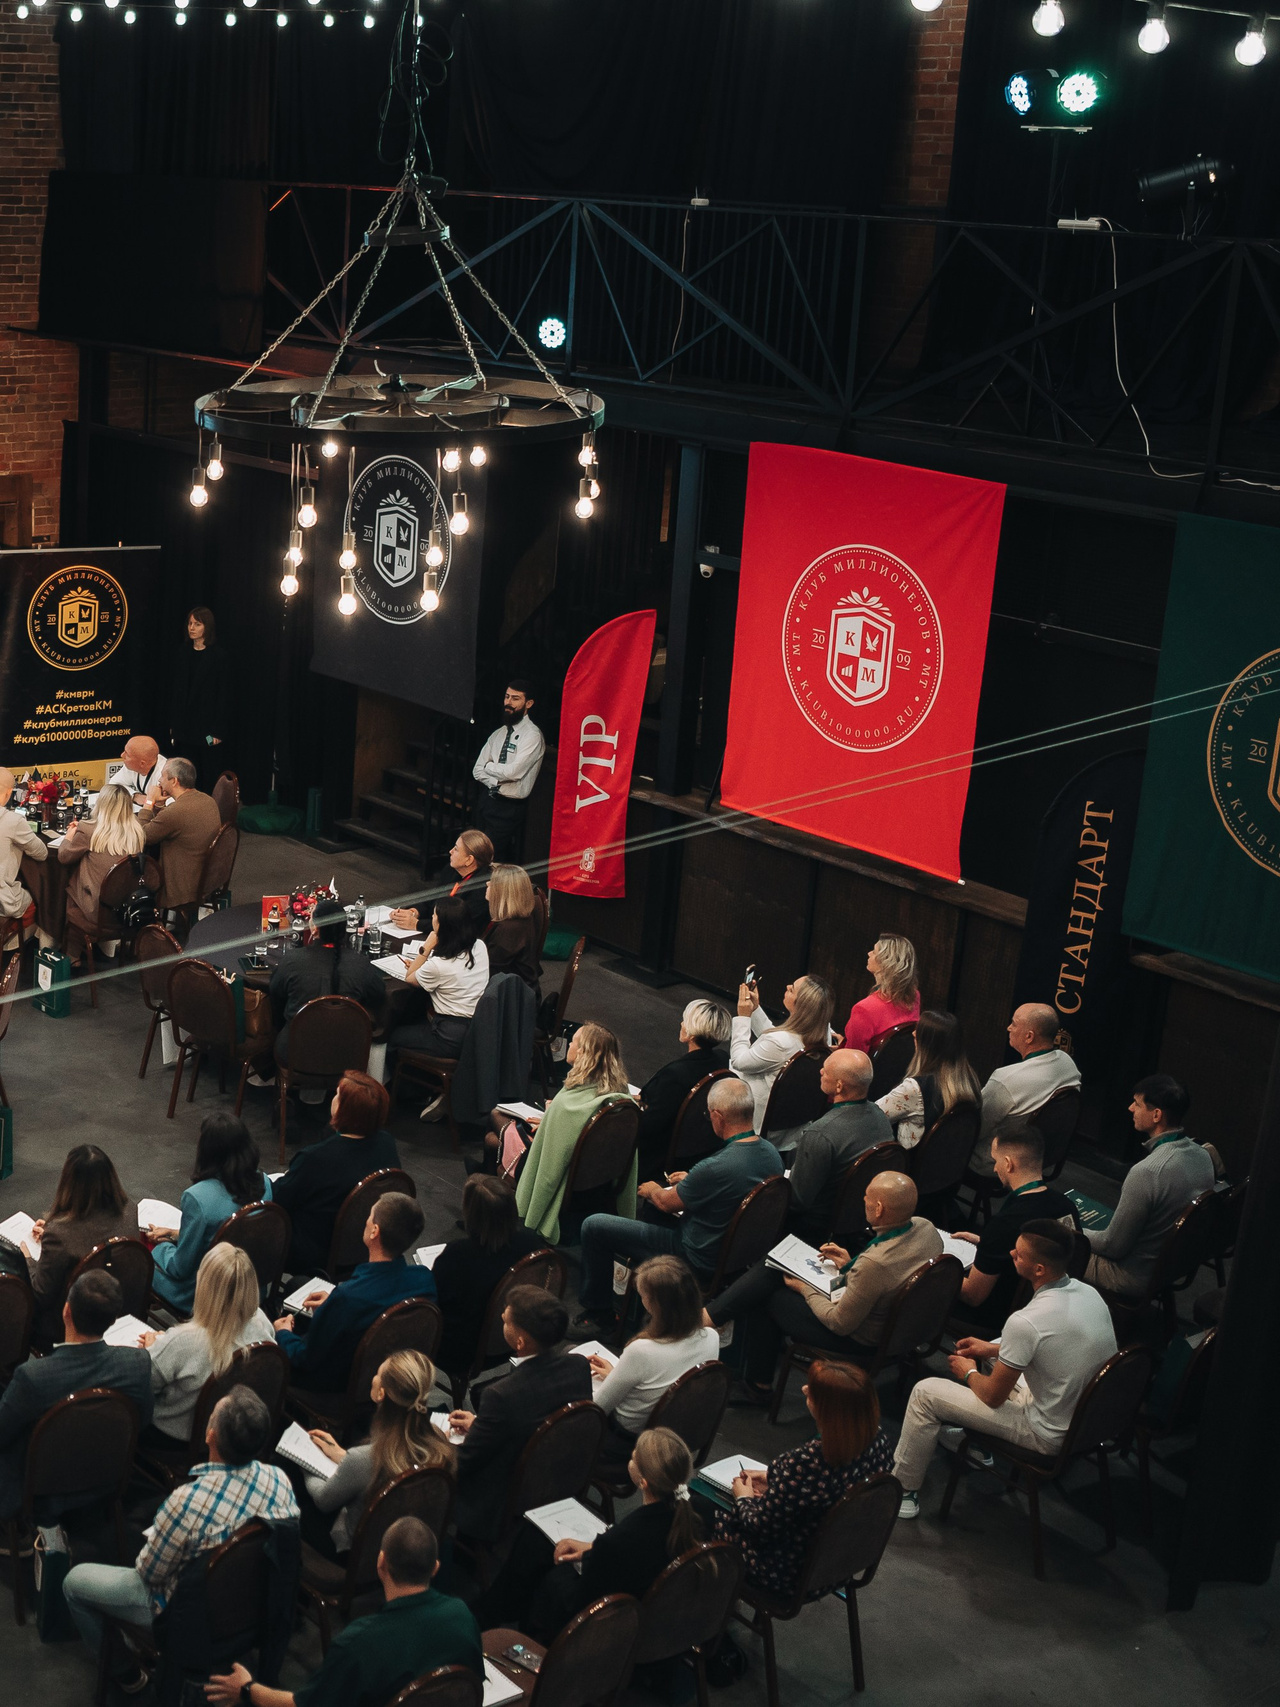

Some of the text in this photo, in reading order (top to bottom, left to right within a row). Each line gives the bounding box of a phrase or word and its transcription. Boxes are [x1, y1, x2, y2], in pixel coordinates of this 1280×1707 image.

[354, 479, 373, 511] КЛУБ
[363, 529, 374, 538] 20
[37, 573, 120, 608] КЛУБ МИЛЛИОНЕРОВ
[356, 567, 418, 613] KLUB1000000
[799, 558, 931, 640] КЛУБ МИЛЛИОНЕРОВ
[812, 632, 826, 644] 20
[845, 631, 856, 647] К
[896, 653, 911, 666] 09
[861, 667, 875, 683] М
[56, 690, 95, 700] #кмврн
[35, 700, 112, 715] #АСКретовКМ
[800, 679, 914, 739] KLUB1000000.RU
[23, 715, 123, 730] #клубмиллионеров
[13, 728, 131, 745] #клуб1000000Воронеж
[1249, 744, 1267, 757] 20
[575, 714, 619, 813] VIP
[63, 770, 80, 778] ВАС
[1055, 801, 1115, 1014] СТАНДАРТ
